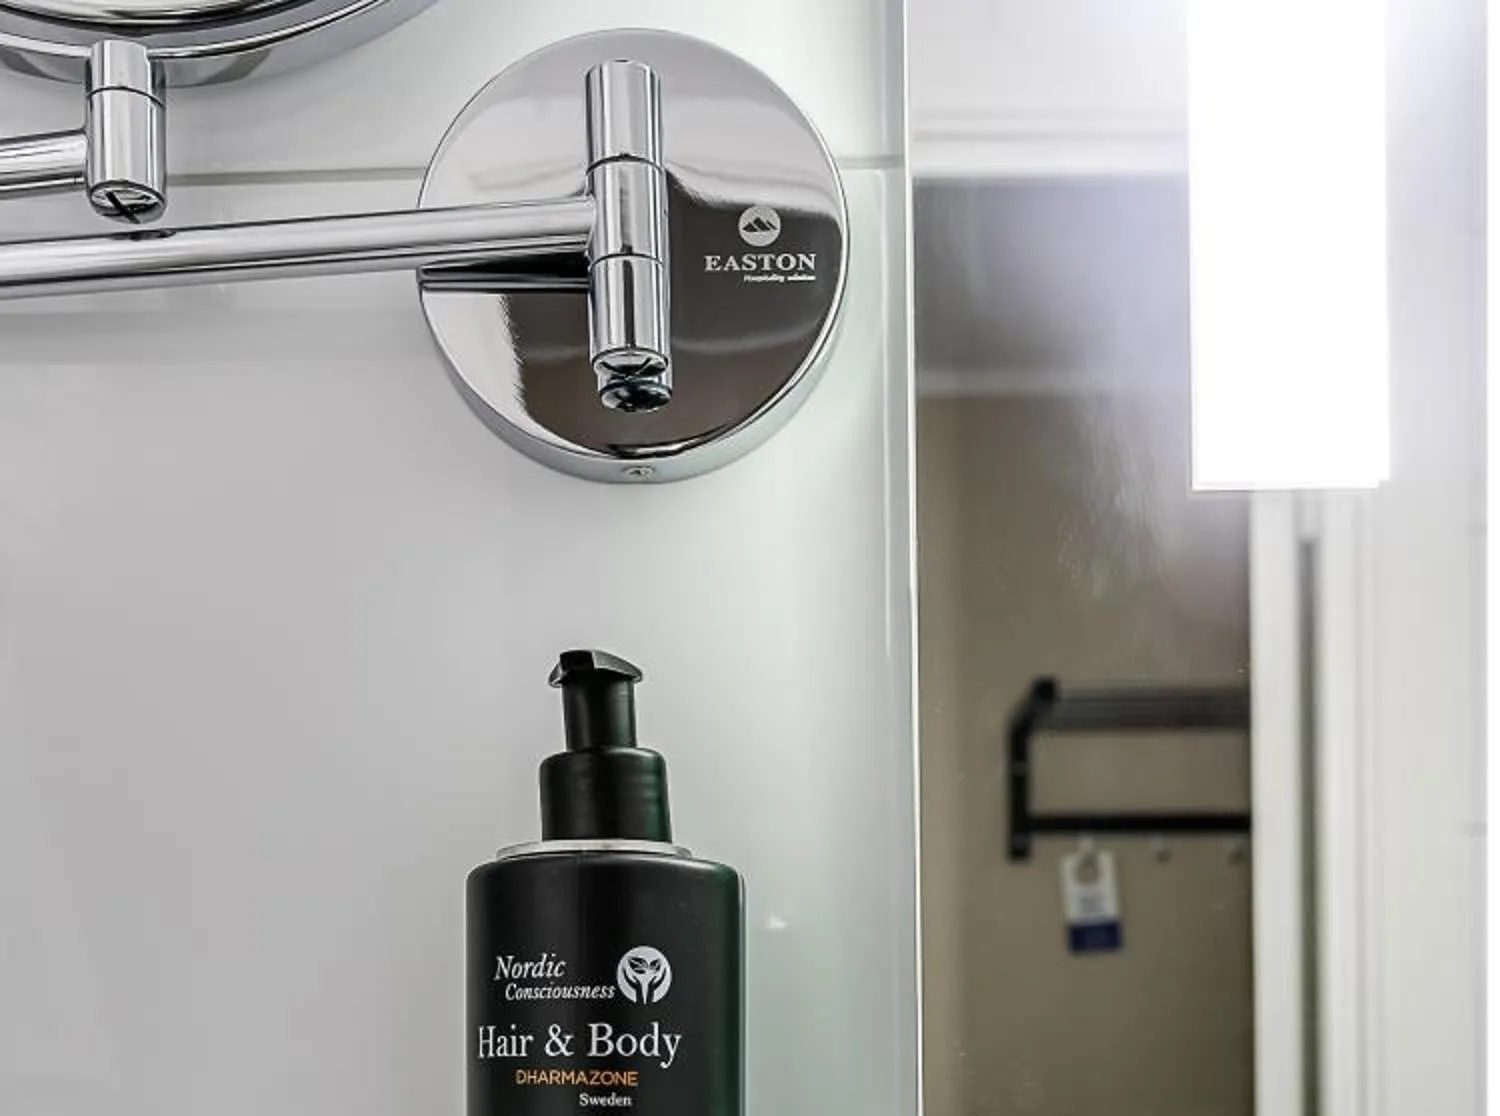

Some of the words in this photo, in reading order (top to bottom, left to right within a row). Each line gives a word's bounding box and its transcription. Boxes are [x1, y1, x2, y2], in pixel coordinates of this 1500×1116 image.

[704, 253, 816, 272] EASTON
[494, 953, 568, 981] Nordic
[505, 981, 616, 1001] Consciousness
[478, 1024, 535, 1059] Hair
[544, 1023, 575, 1057] &
[587, 1021, 683, 1069] Body
[515, 1069, 639, 1088] DHARMAZONE
[579, 1092, 633, 1108] Sweden
